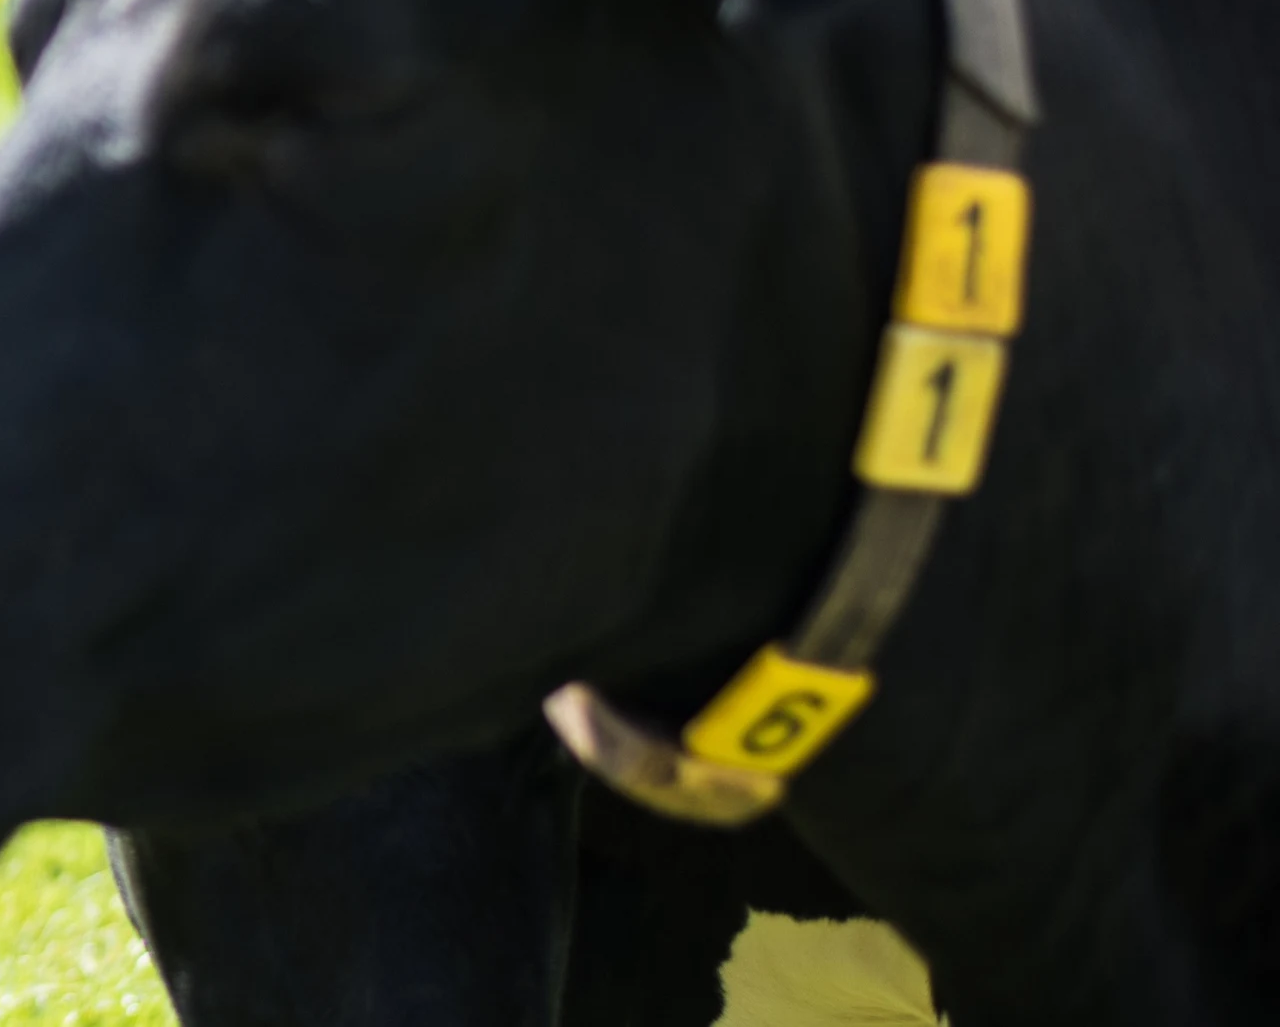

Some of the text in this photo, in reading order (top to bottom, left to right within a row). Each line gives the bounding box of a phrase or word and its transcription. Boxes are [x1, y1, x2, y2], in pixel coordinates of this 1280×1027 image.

[954, 198, 987, 306] 1
[921, 356, 958, 463] 1
[740, 689, 827, 757] 6
